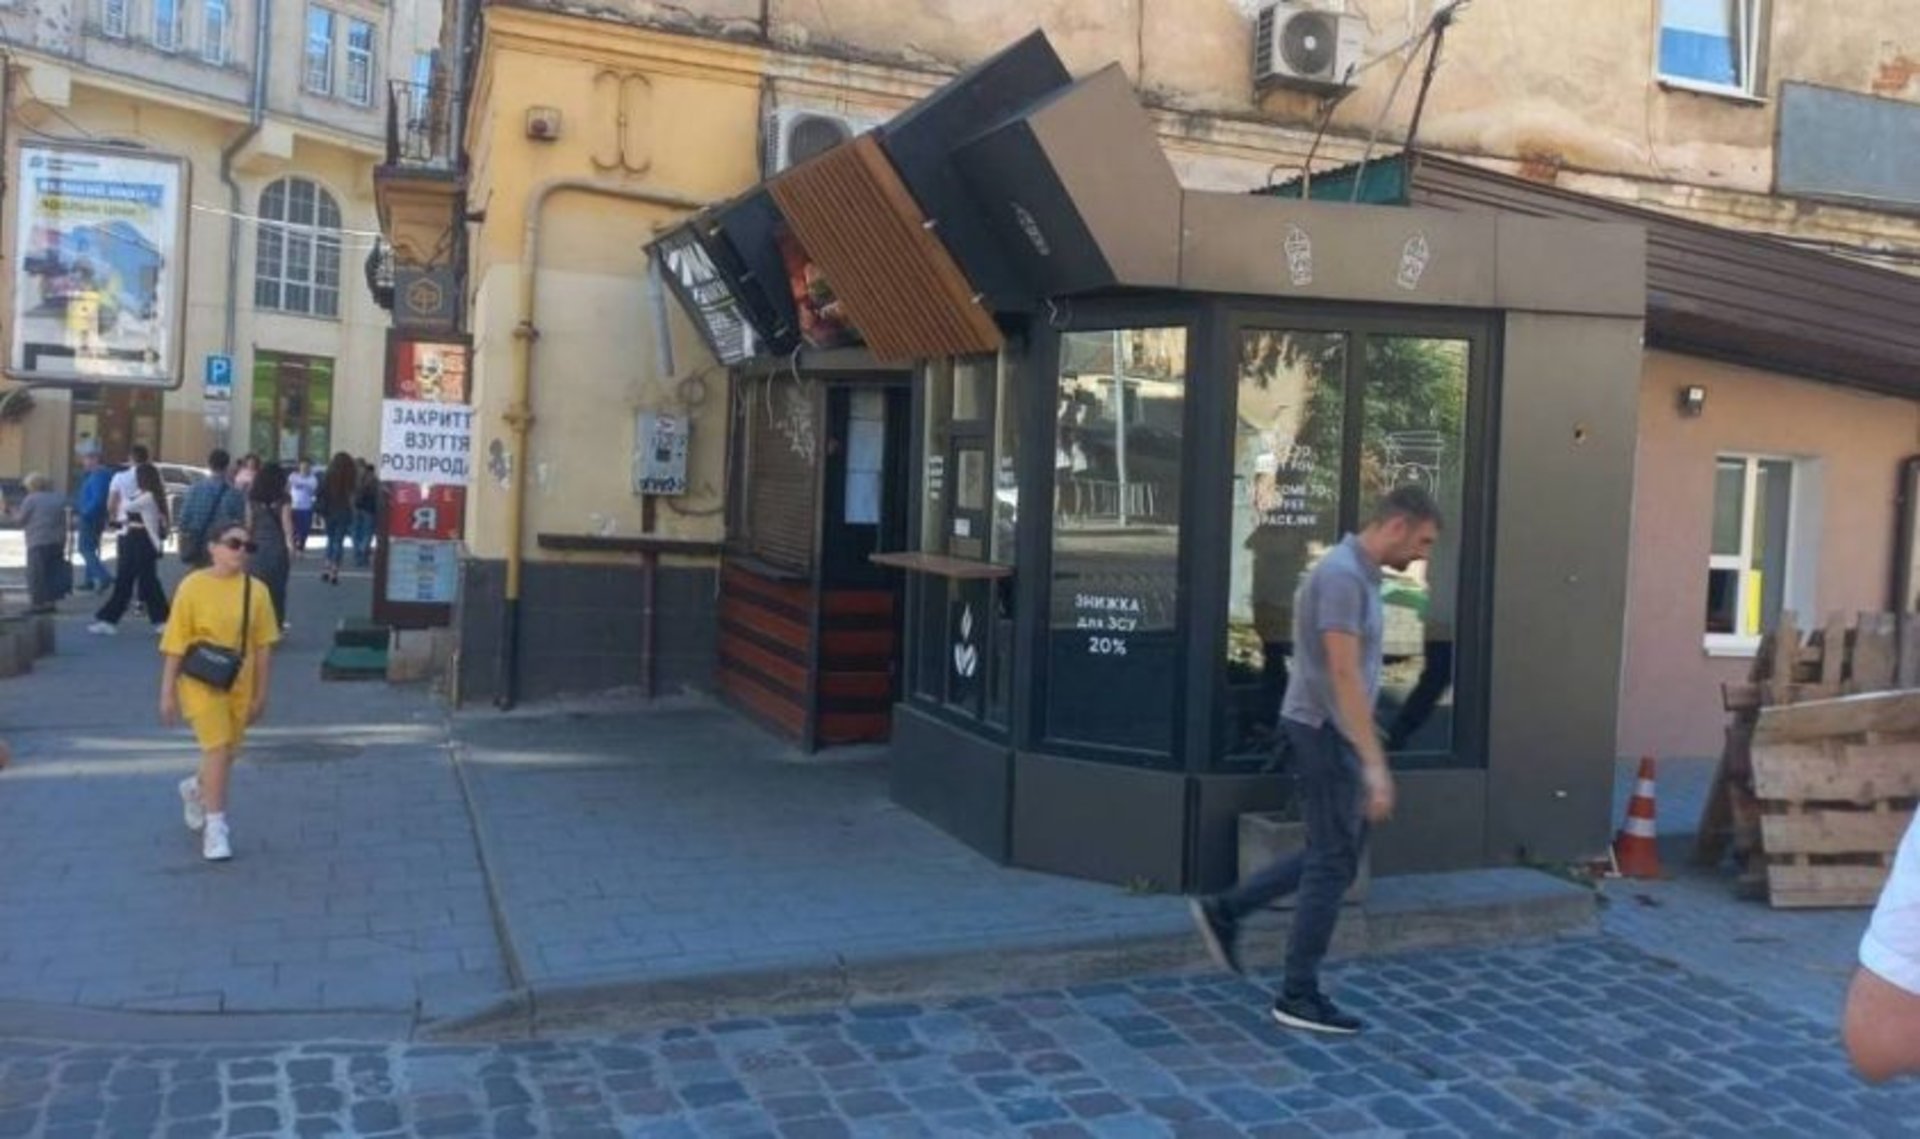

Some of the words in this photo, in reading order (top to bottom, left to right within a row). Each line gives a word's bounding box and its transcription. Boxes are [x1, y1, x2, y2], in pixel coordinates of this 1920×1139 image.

[212, 359, 227, 382] P
[404, 431, 470, 452] ВЗУТТЯ
[1074, 593, 1139, 611] ЗНИЖКА
[1107, 616, 1138, 632] ЗСУ
[1088, 636, 1127, 656] 20%
